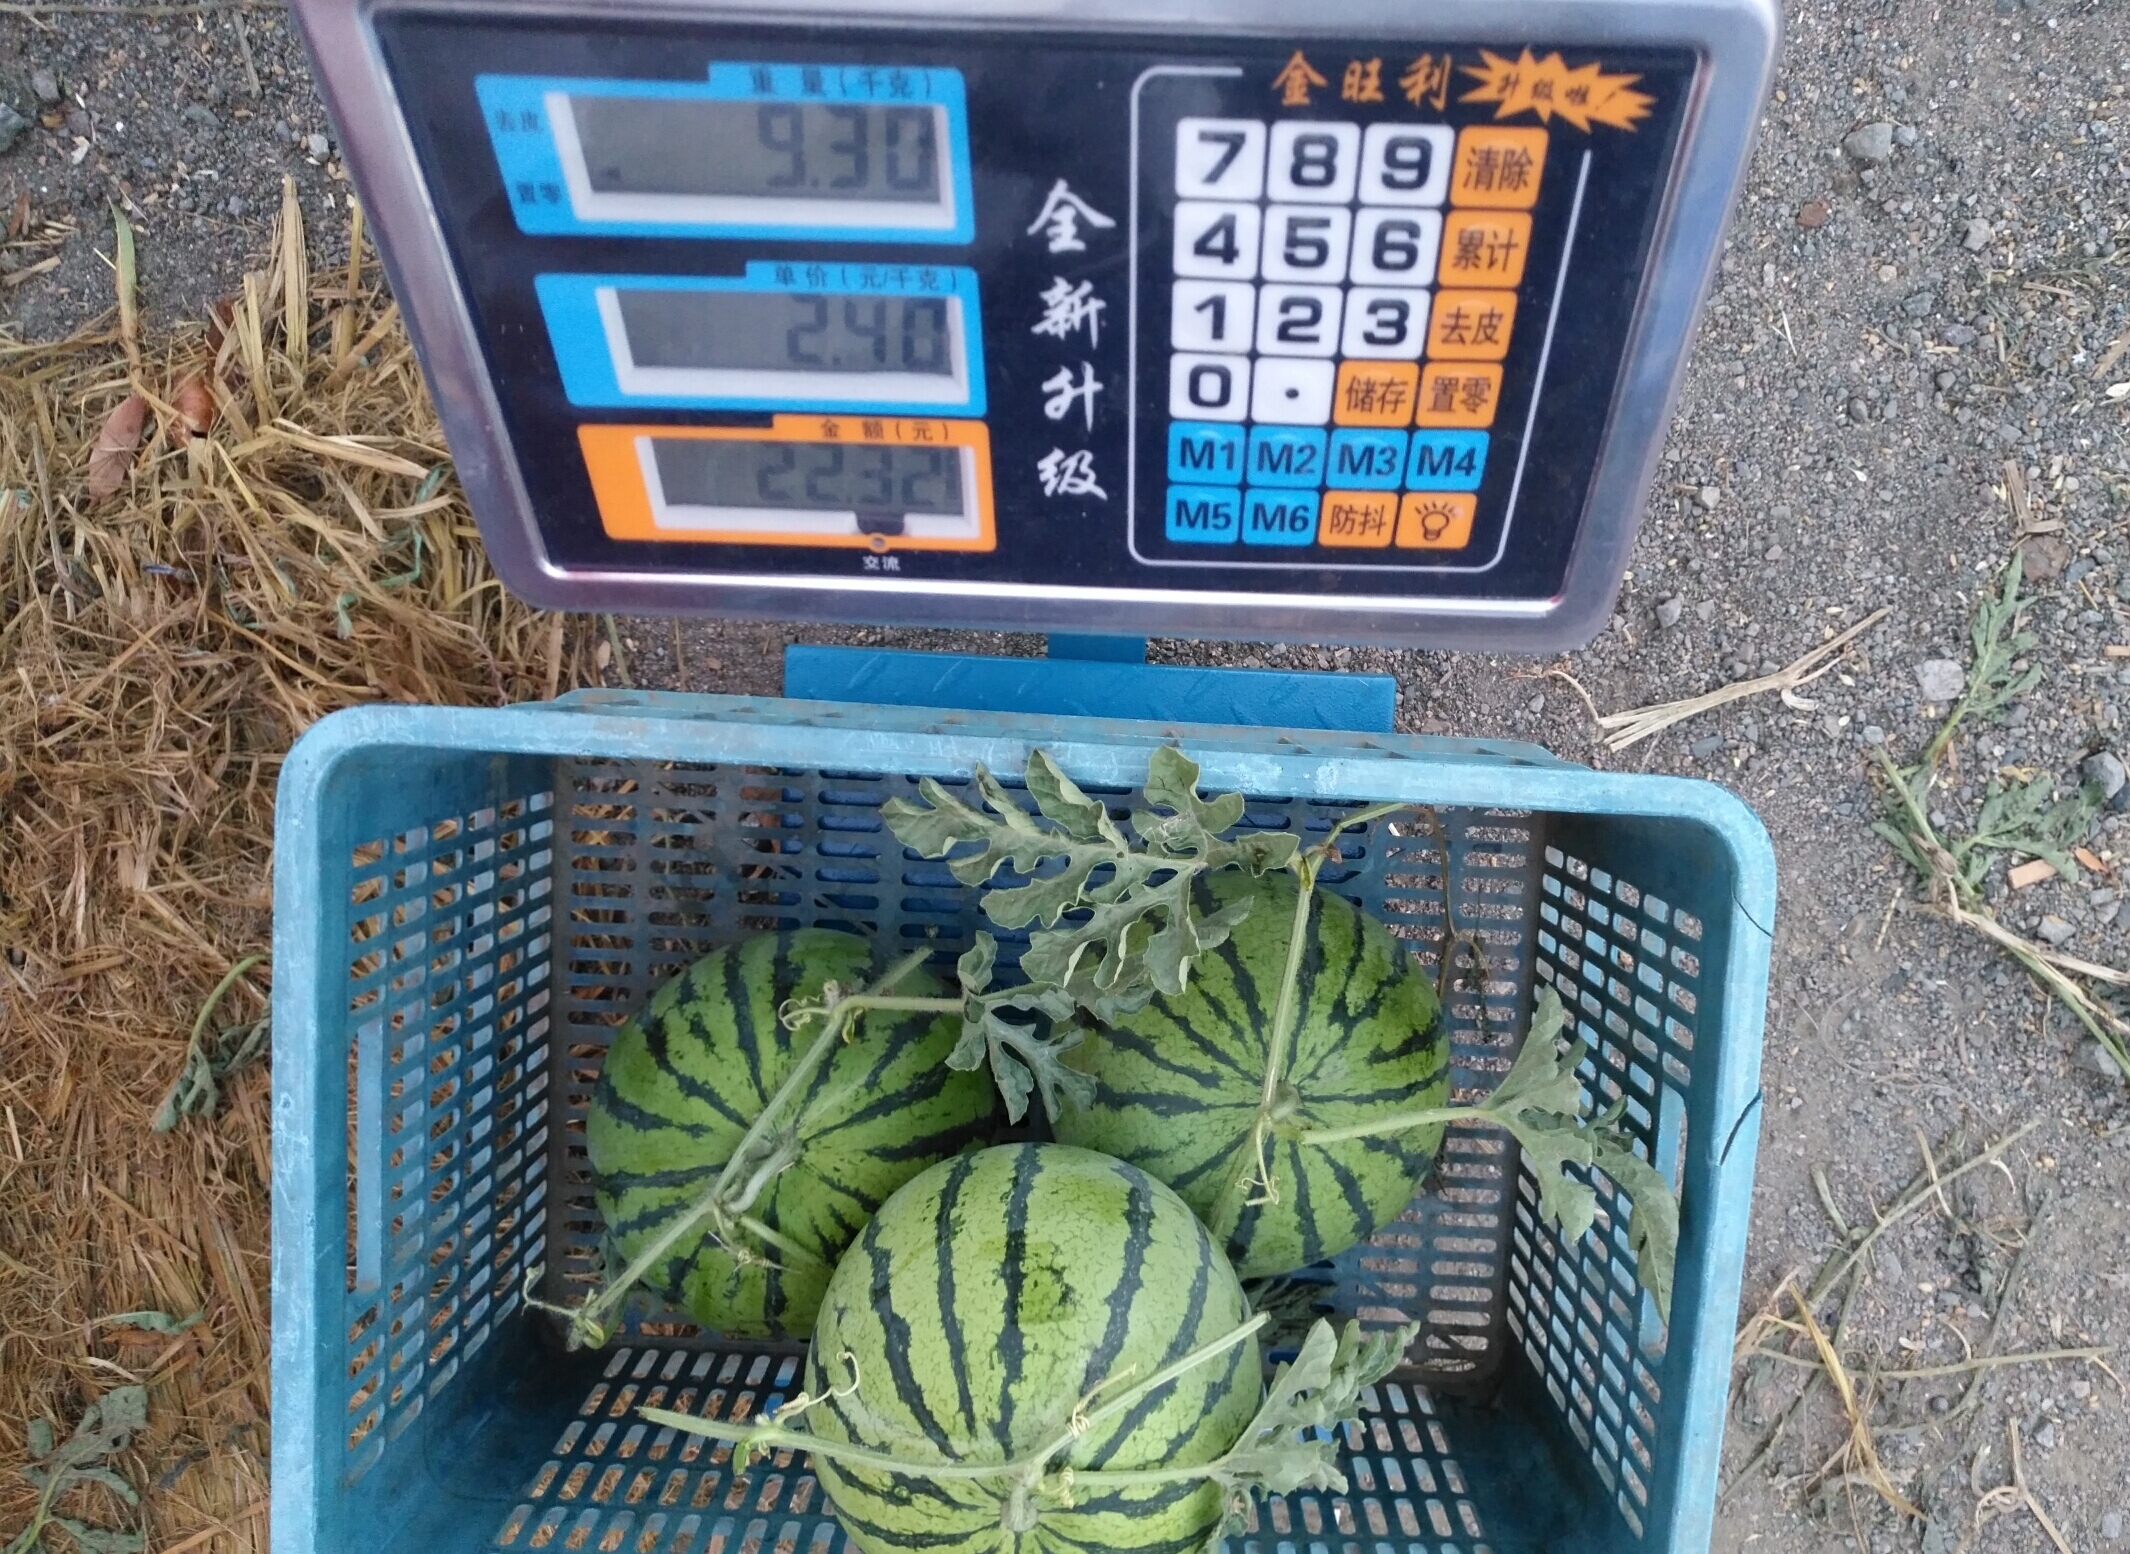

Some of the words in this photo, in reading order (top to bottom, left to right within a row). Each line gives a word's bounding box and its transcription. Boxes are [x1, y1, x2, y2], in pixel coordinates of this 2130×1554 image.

[1271, 49, 1452, 112] 金旺利
[758, 103, 934, 190] 9.30
[1197, 130, 1246, 185] 7
[1289, 133, 1339, 188] 8
[1381, 135, 1433, 190] 9
[1464, 146, 1536, 193] 清除
[1192, 213, 1240, 266] 4
[1283, 217, 1330, 269] 5
[1371, 219, 1422, 272] 6
[1451, 228, 1518, 272] 累计
[786, 292, 949, 368] 2.40
[1026, 178, 1116, 501] 全新升级
[1194, 294, 1227, 341] 1
[1276, 297, 1323, 344] 2
[1362, 299, 1410, 346] 3
[1439, 304, 1504, 347] 去皮
[1187, 364, 1232, 408] 0
[1345, 376, 1408, 415] 储存
[1429, 375, 1492, 414] 置零
[1179, 438, 1236, 473] M1
[1256, 441, 1317, 475] M2
[1337, 442, 1398, 477] M3
[1415, 443, 1477, 478] M4
[1174, 498, 1232, 532] M5
[1250, 502, 1310, 534] M6
[1329, 503, 1387, 537] 防抖
[862, 555, 901, 571] 交流
